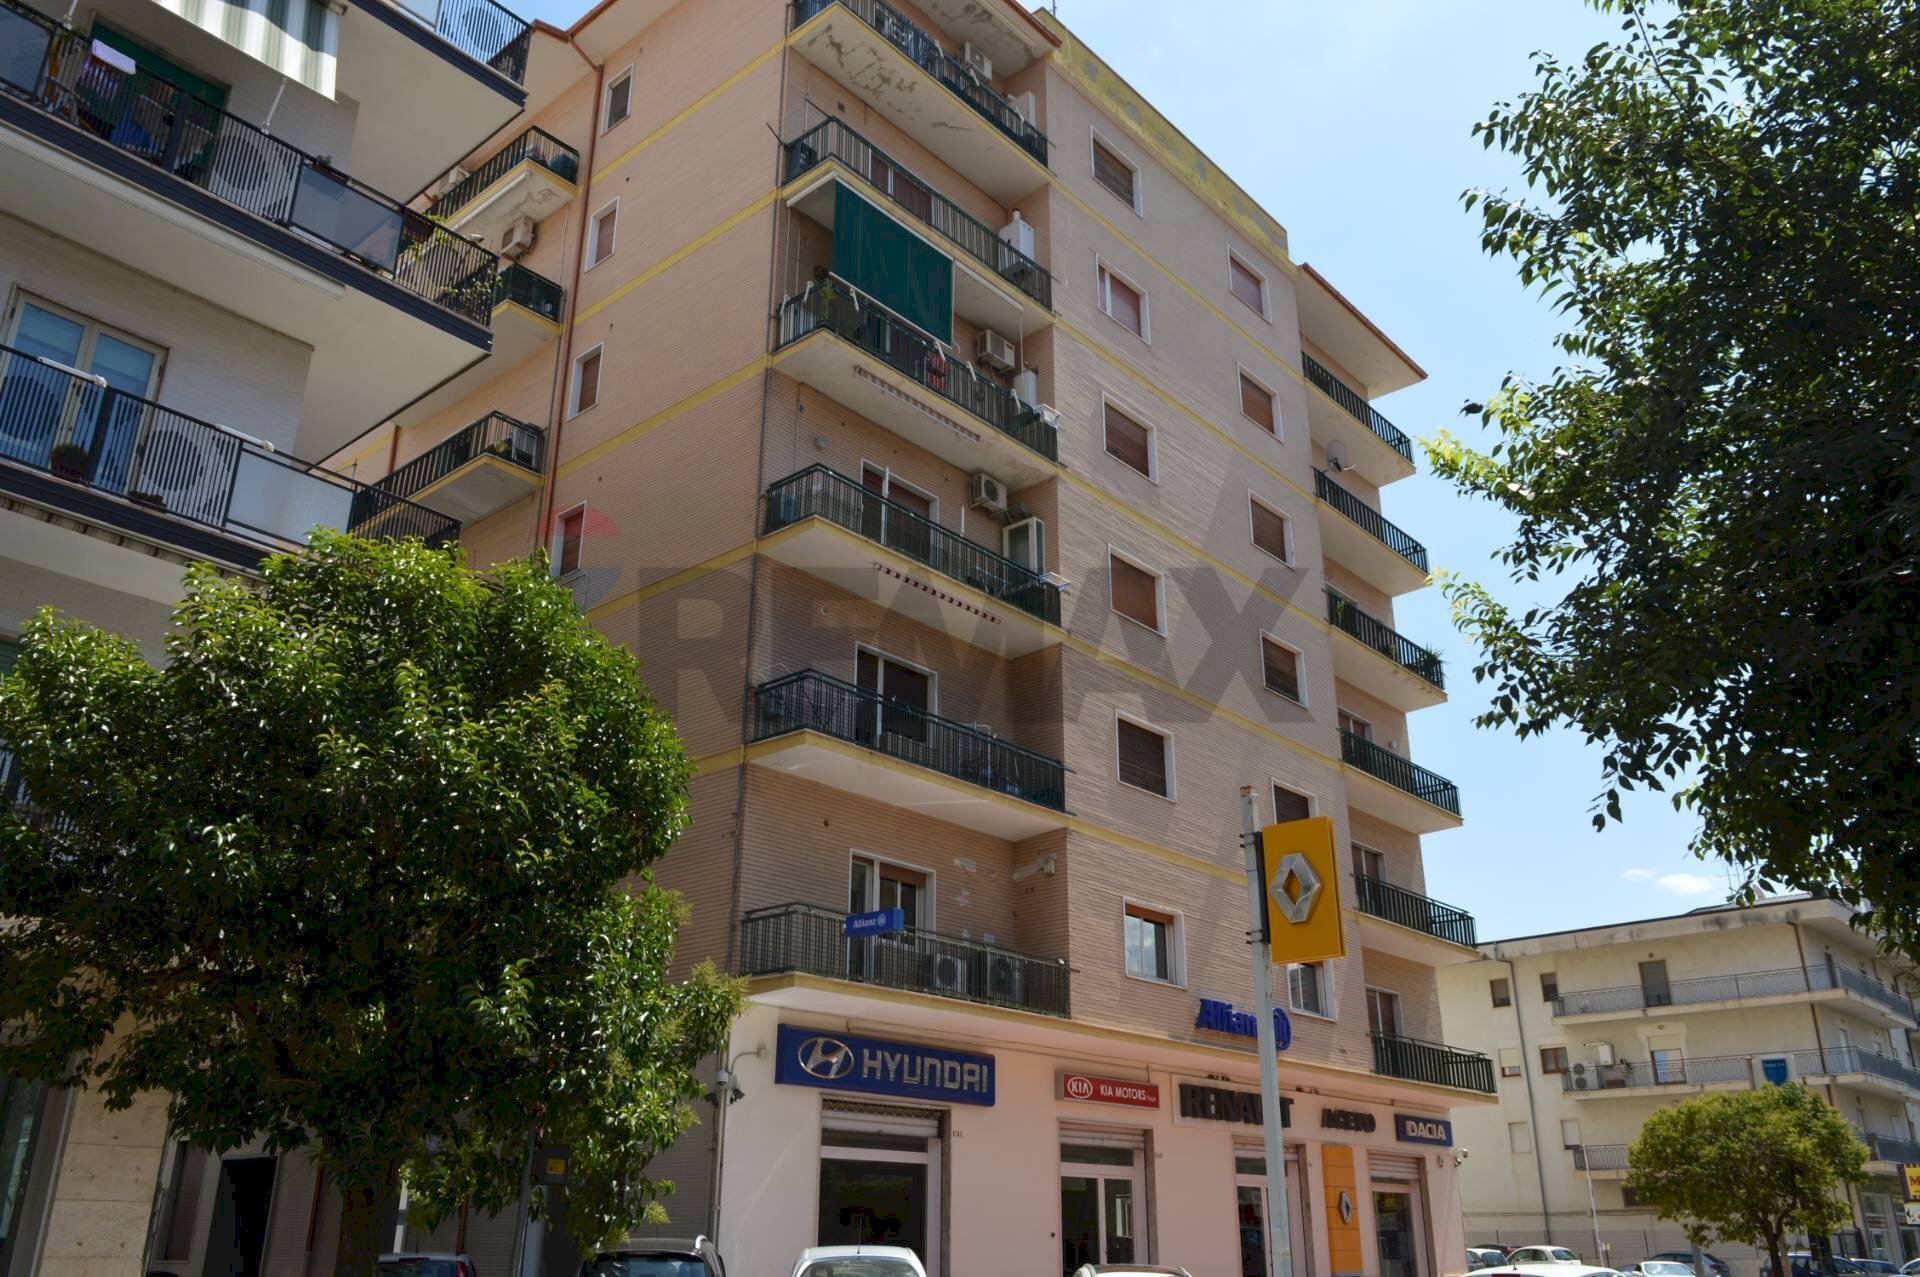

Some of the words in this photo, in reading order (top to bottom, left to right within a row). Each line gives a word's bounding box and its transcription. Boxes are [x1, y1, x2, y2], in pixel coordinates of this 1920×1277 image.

[853, 918, 877, 929] Allianz
[1195, 998, 1260, 1038] Allian
[862, 1048, 989, 1093] HYUNDAI
[1100, 1084, 1114, 1097] KIA
[1115, 1086, 1147, 1101] MOTORS
[1179, 1083, 1294, 1128] RENAT
[1406, 1120, 1447, 1141] DACIA
